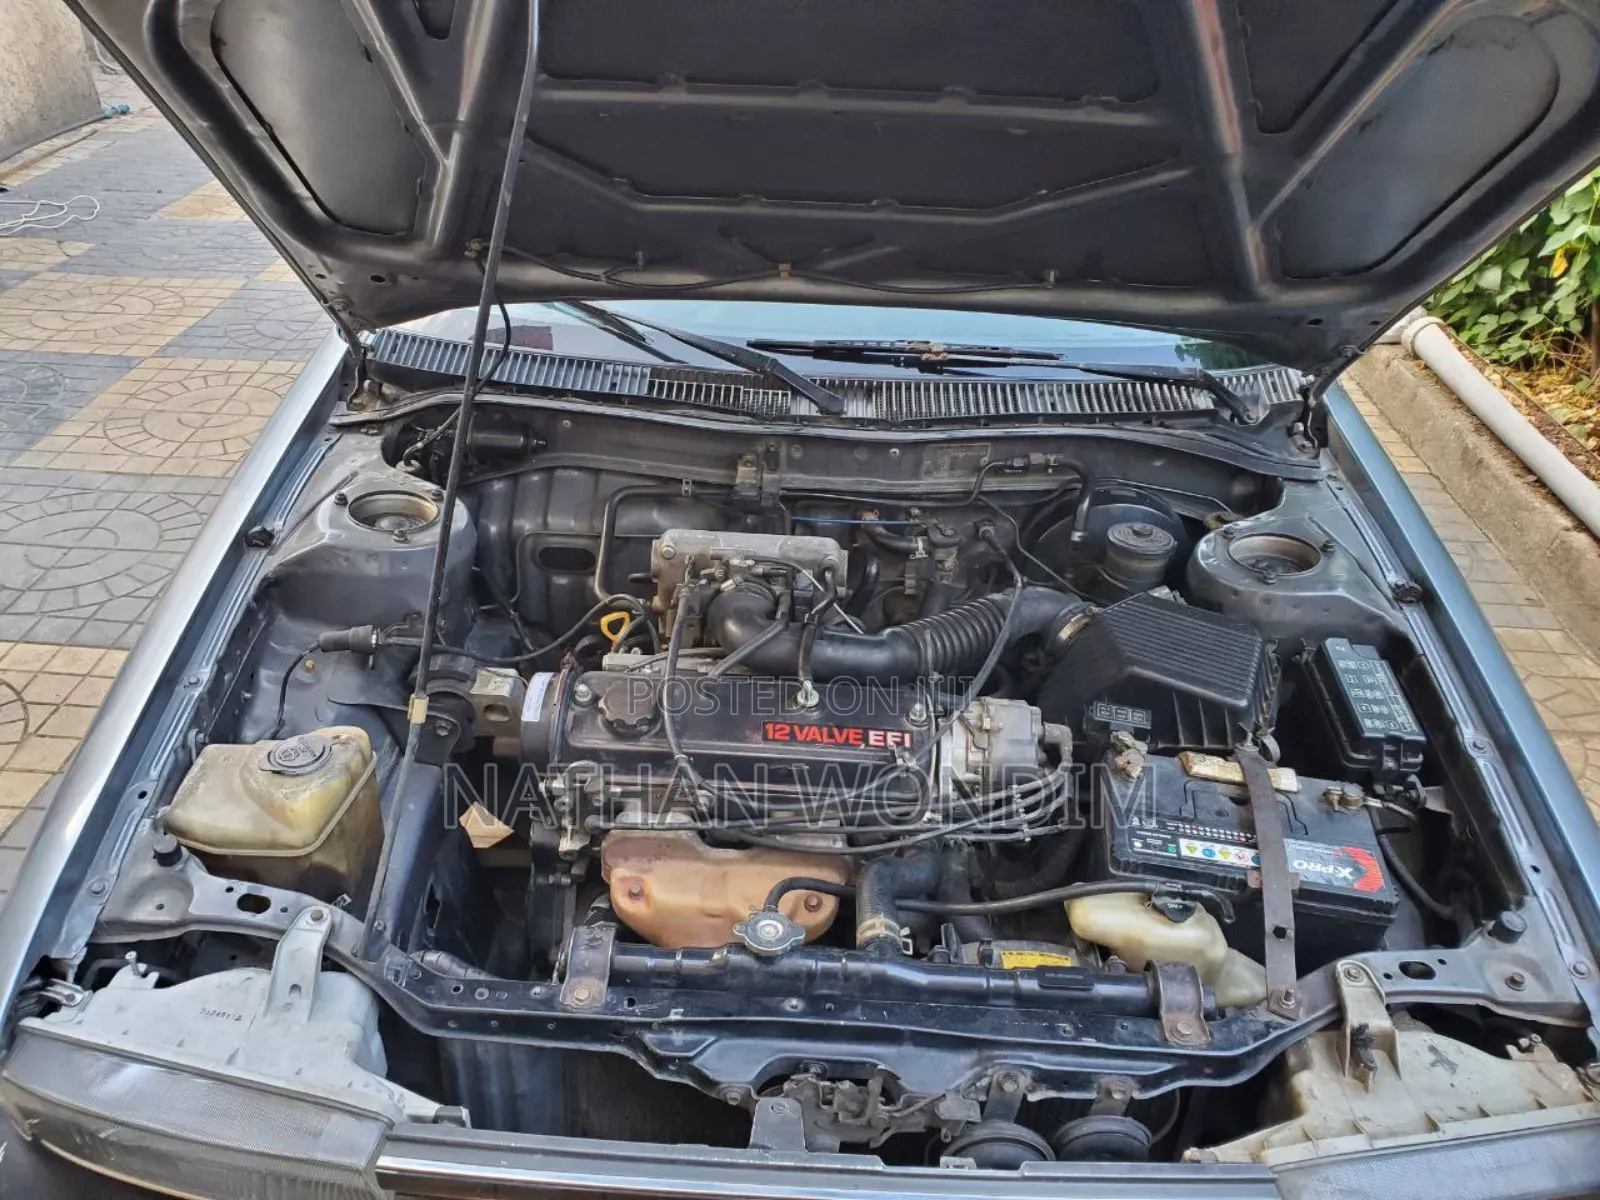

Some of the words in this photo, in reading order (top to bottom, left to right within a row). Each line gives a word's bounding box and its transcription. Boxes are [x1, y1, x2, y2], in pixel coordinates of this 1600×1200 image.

[765, 722, 791, 741] 12
[793, 724, 864, 746] VALVE
[867, 730, 911, 748] EFI
